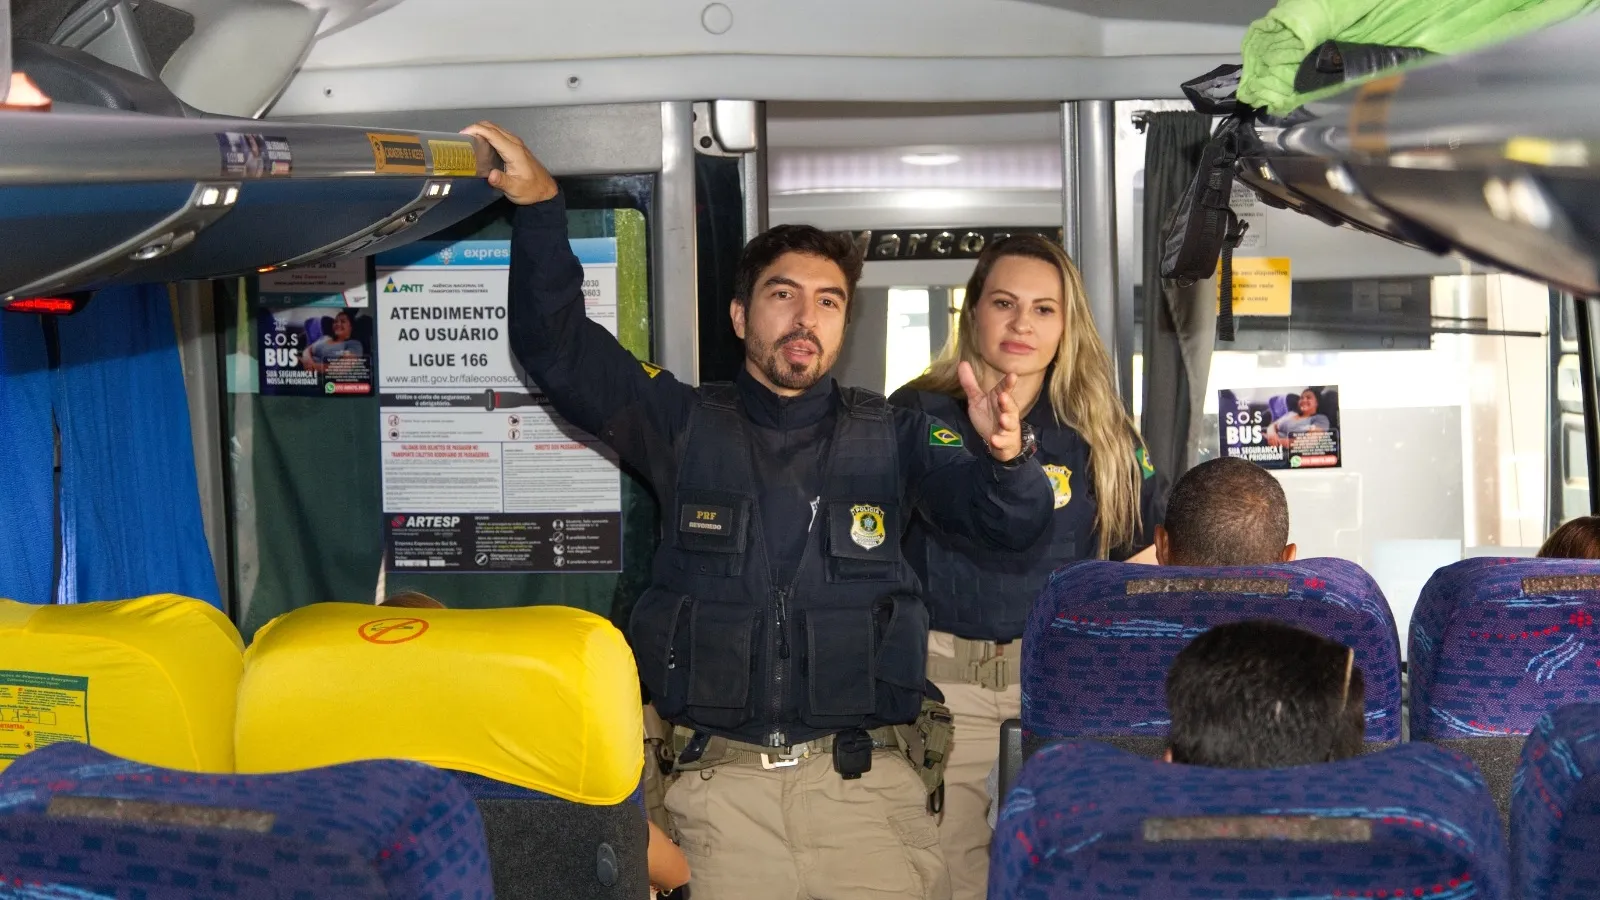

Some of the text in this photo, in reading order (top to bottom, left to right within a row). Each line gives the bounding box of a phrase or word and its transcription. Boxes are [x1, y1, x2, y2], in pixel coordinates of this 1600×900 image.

[399, 284, 424, 293] ANTT
[390, 306, 507, 320] ATENDIMENTO
[398, 324, 499, 341] AO USUÁRIO
[264, 333, 299, 346] S.O.S
[264, 348, 299, 367] BUS
[409, 353, 488, 367] LIGUE 166
[266, 370, 278, 378] SUA
[278, 370, 313, 379] SEGURANÇA
[266, 377, 318, 385] NOSSA PRIORIDADE
[1225, 410, 1263, 425] S.O.S
[1226, 425, 1263, 445] BUS
[1227, 446, 1241, 455] SUA
[1241, 445, 1278, 455] SEGURANÇA
[406, 516, 460, 528] ARTESP
[696, 510, 717, 521] PRF
